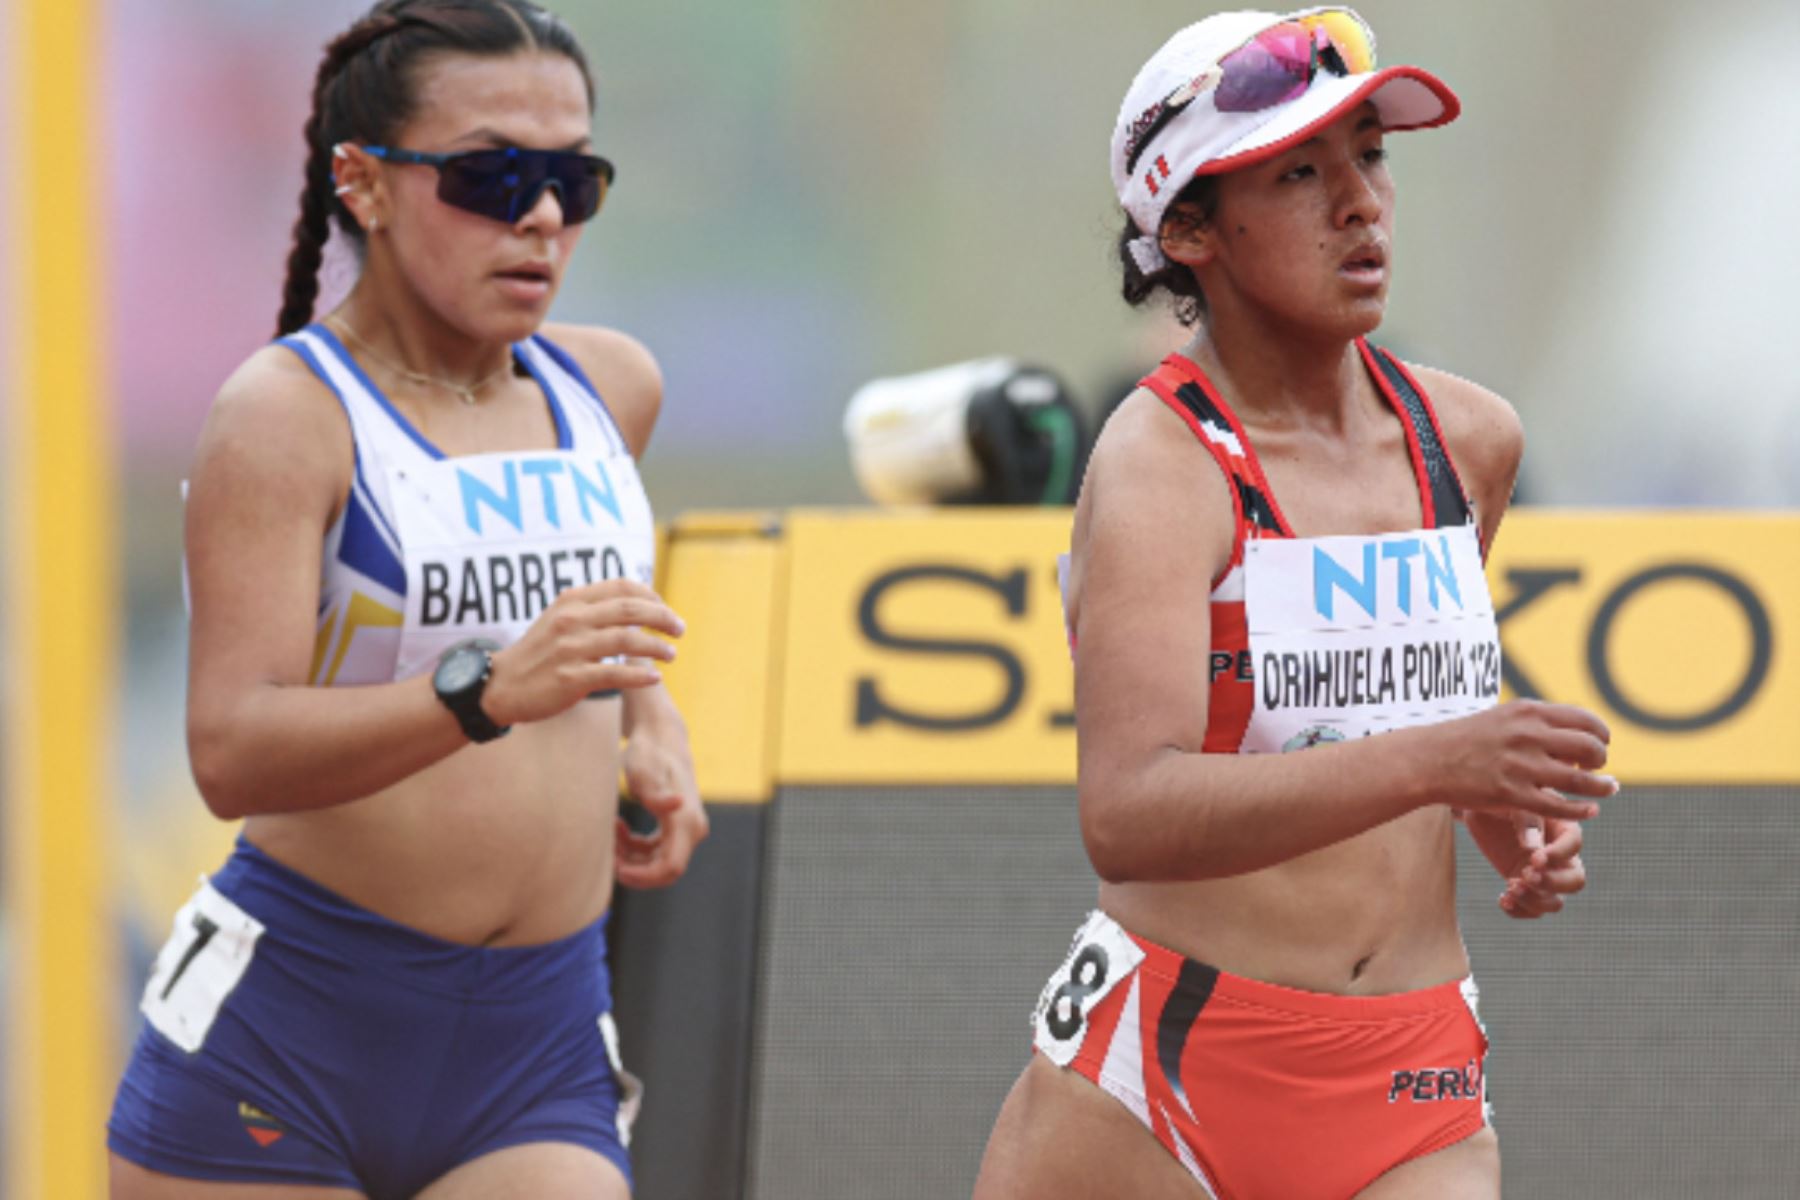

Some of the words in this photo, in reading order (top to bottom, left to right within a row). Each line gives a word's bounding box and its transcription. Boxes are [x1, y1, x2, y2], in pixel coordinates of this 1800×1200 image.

[456, 459, 624, 535] NTN
[420, 546, 626, 626] BARRETO
[1313, 535, 1464, 621] NTN
[856, 563, 1773, 732] SKO
[1209, 650, 1254, 682] PE
[1263, 647, 1395, 711] ORIHUELA
[1046, 943, 1109, 1041] 8
